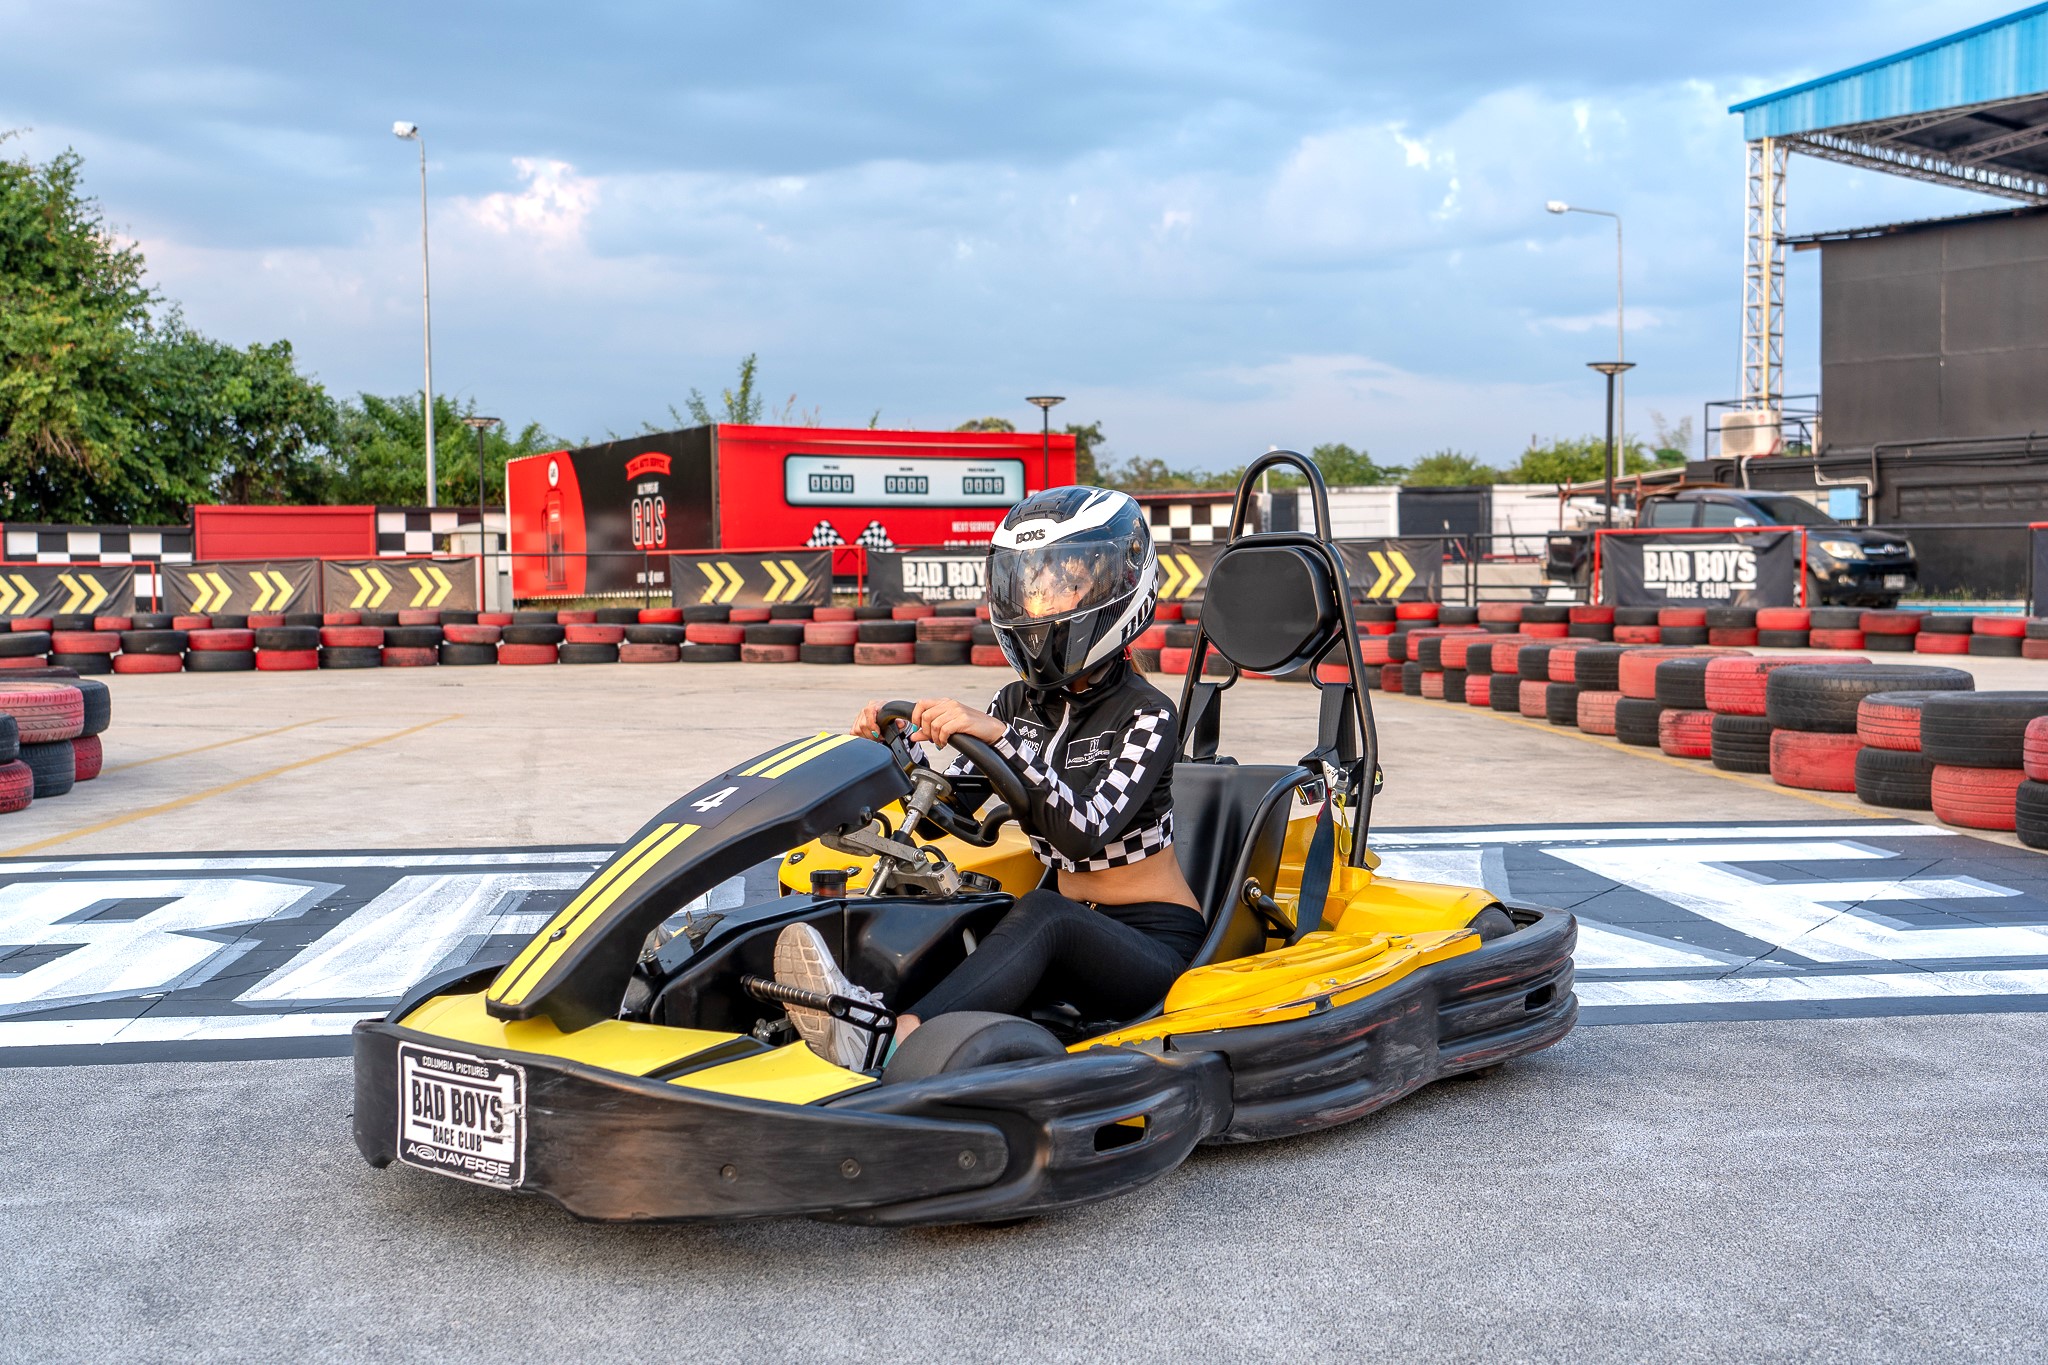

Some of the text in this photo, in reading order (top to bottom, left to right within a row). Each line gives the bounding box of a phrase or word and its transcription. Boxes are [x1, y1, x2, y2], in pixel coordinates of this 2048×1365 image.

[631, 496, 666, 549] GAS
[1016, 528, 1046, 544] BOXS
[902, 562, 986, 587] BAD BOY
[1643, 551, 1757, 582] BAD BOYS
[923, 586, 982, 600] RACE CLUB
[1666, 582, 1731, 599] RACE CLUB
[690, 786, 740, 812] 4
[421, 1055, 490, 1078] COLUMBIA PICTURES
[411, 1078, 504, 1134] BAD BOYS
[432, 1125, 483, 1152] RACE CLUB
[406, 1142, 511, 1177] AQUAVERSE
